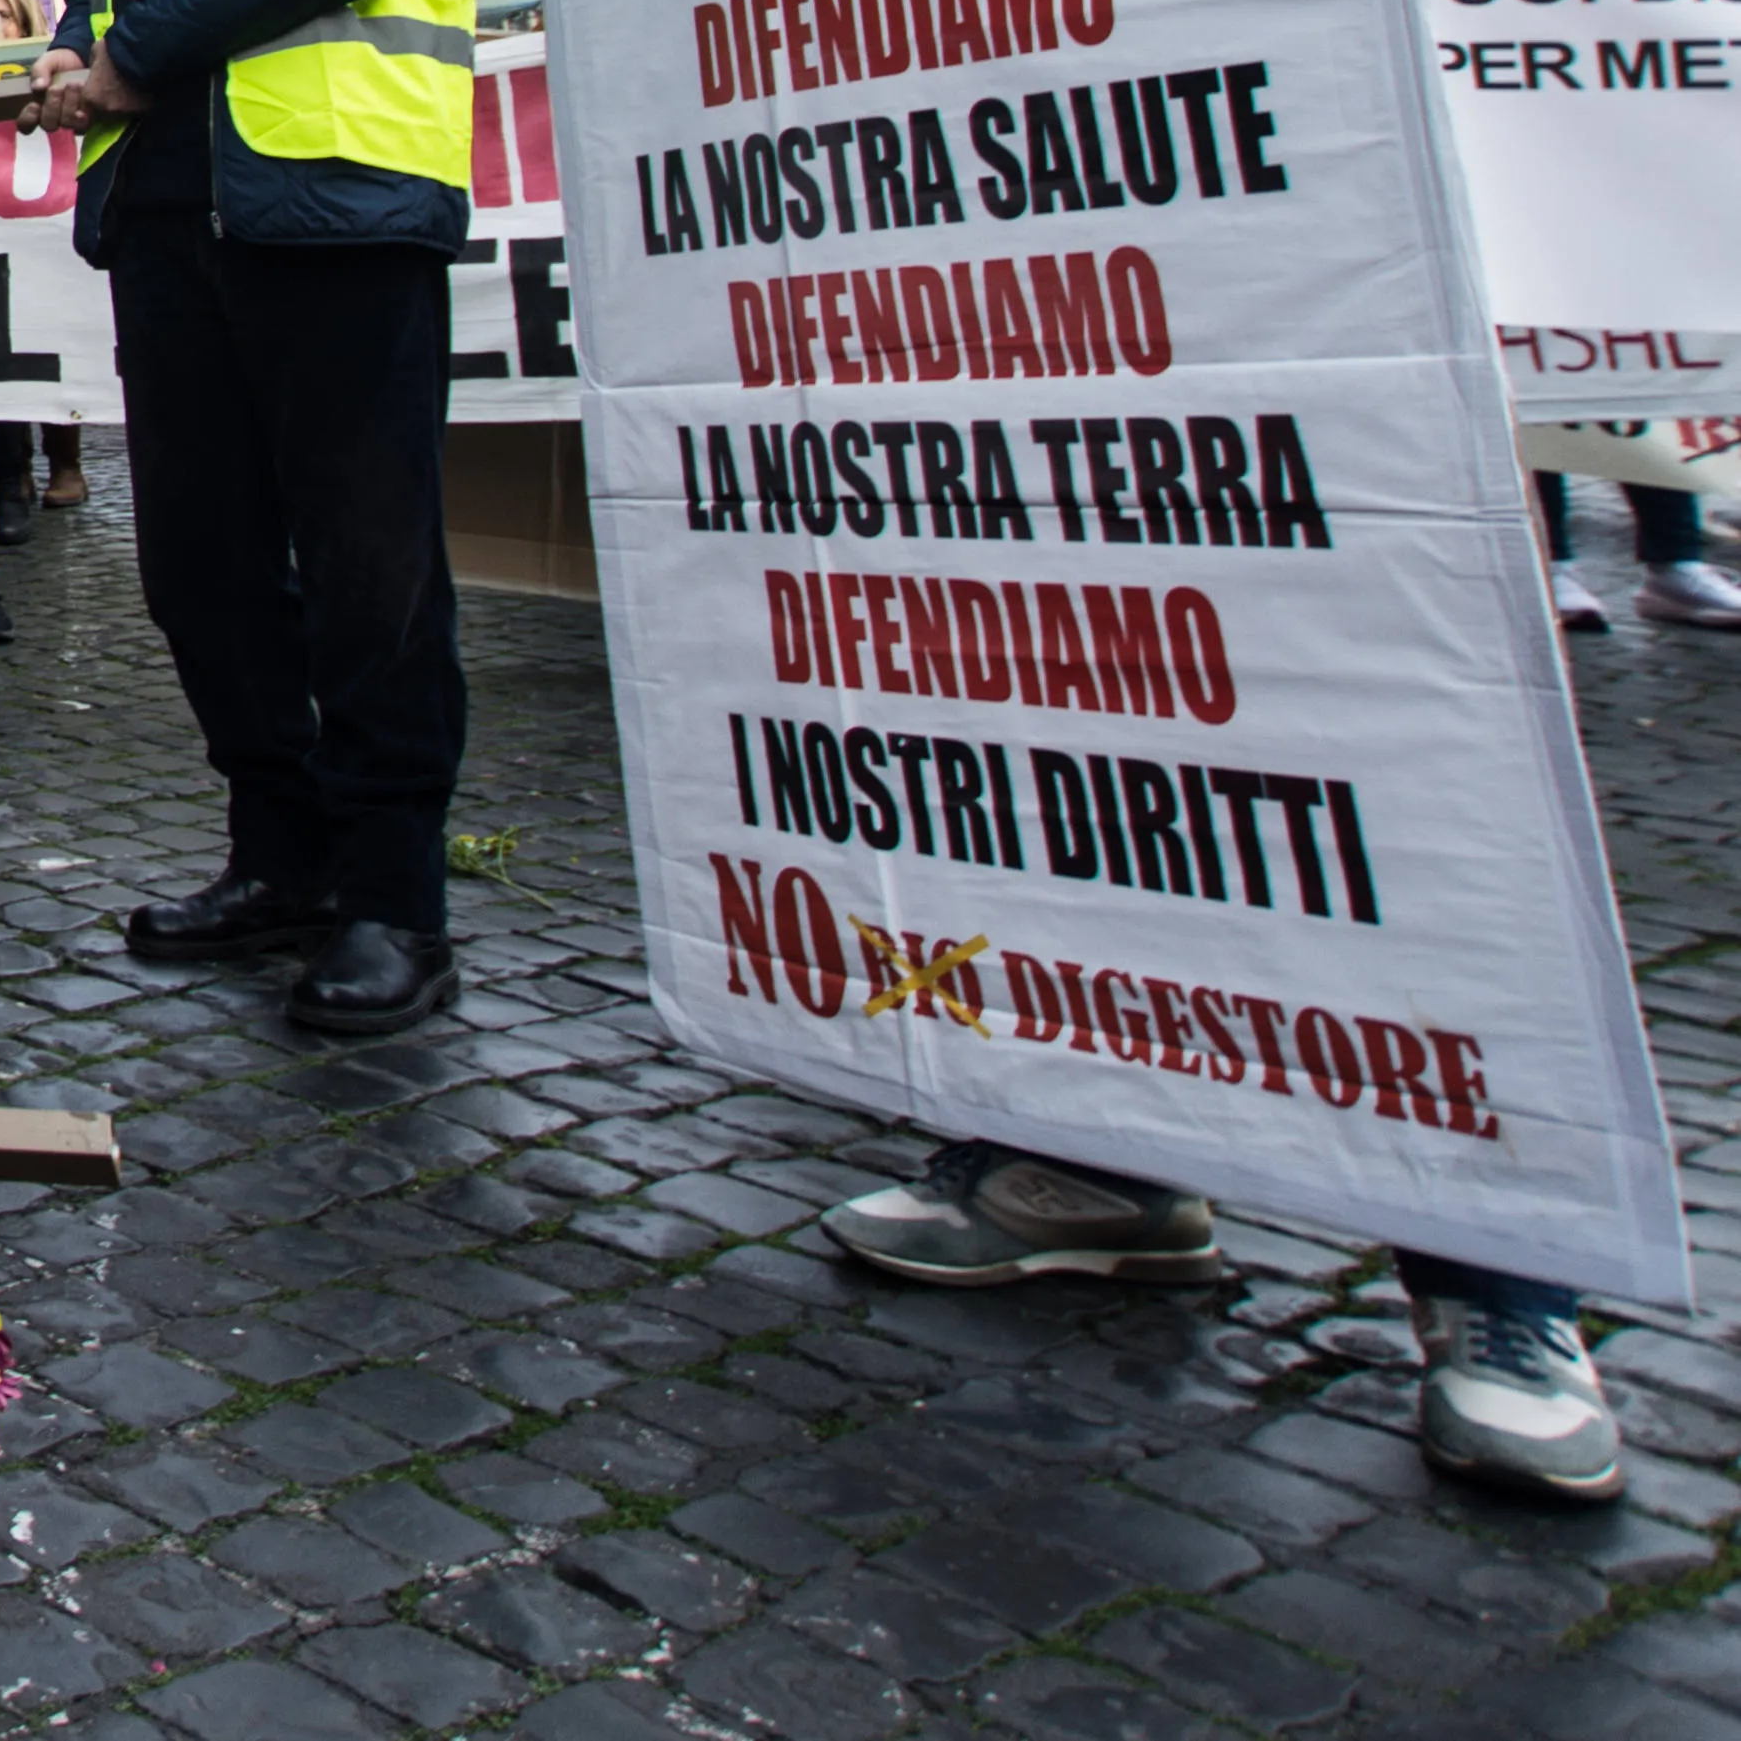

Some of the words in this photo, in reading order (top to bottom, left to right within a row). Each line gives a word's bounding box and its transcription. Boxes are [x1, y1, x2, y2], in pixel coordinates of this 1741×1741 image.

[636, 148, 703, 256] LA
[702, 108, 966, 249] NOSTRA
[968, 60, 1288, 220] SALUTE
[727, 244, 1172, 388] DIFENDIAMO
[677, 424, 748, 532] LA
[749, 419, 1035, 541] NOSTRA
[1029, 414, 1334, 550] TERRA
[765, 568, 1237, 726] DIFENDIAMO
[728, 713, 760, 827] I
[761, 716, 1025, 871] NOSTRI
[1028, 746, 1382, 926] DIRITTI
[709, 852, 847, 1019] NO
[857, 923, 985, 1027] BIO
[1000, 950, 1500, 1141] DIGESTORE
